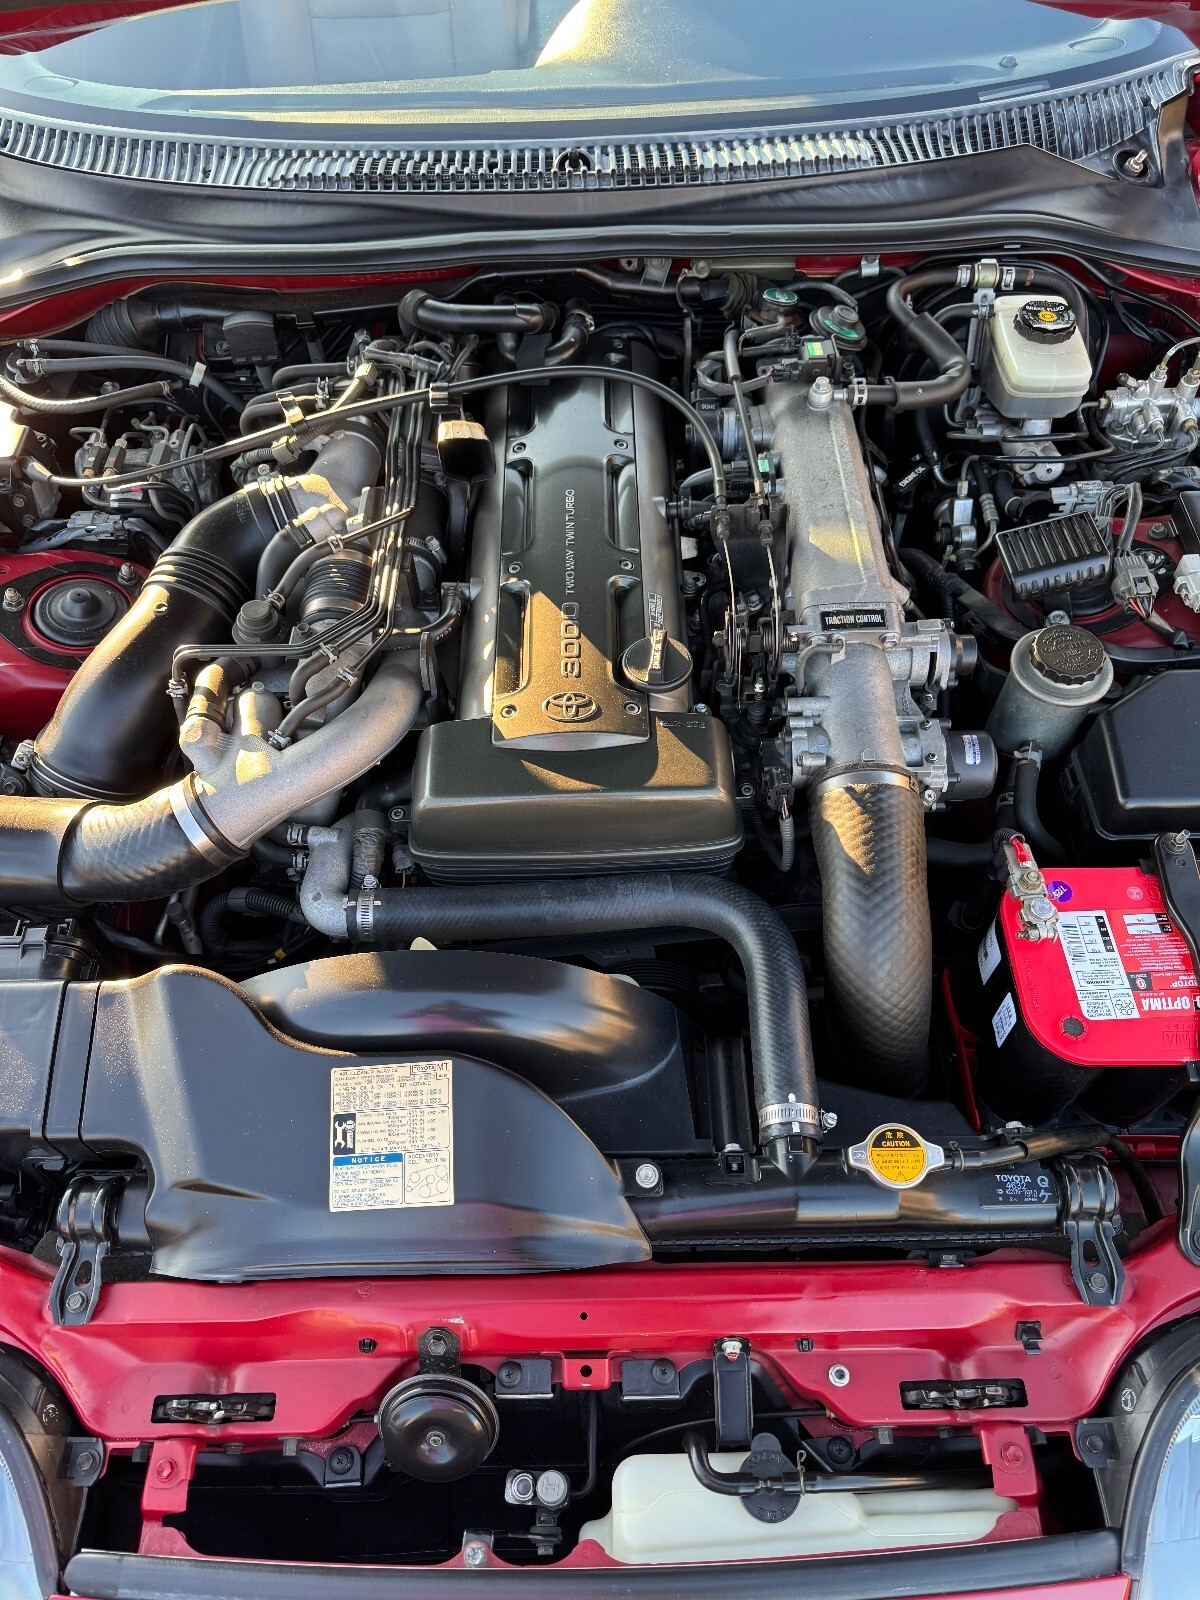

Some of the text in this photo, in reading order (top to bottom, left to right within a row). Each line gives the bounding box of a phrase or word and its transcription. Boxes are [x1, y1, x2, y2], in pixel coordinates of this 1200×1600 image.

[825, 614, 884, 625] TRACTION CONTROL
[560, 601, 581, 678] 3000
[1141, 996, 1191, 1011] OPTIMA
[436, 1062, 448, 1071] MT
[881, 1140, 911, 1148] CAUTION
[351, 1155, 386, 1164] NOTICE
[995, 1174, 1049, 1188] TOYOTA Q
[1006, 1181, 1027, 1190] 4632
